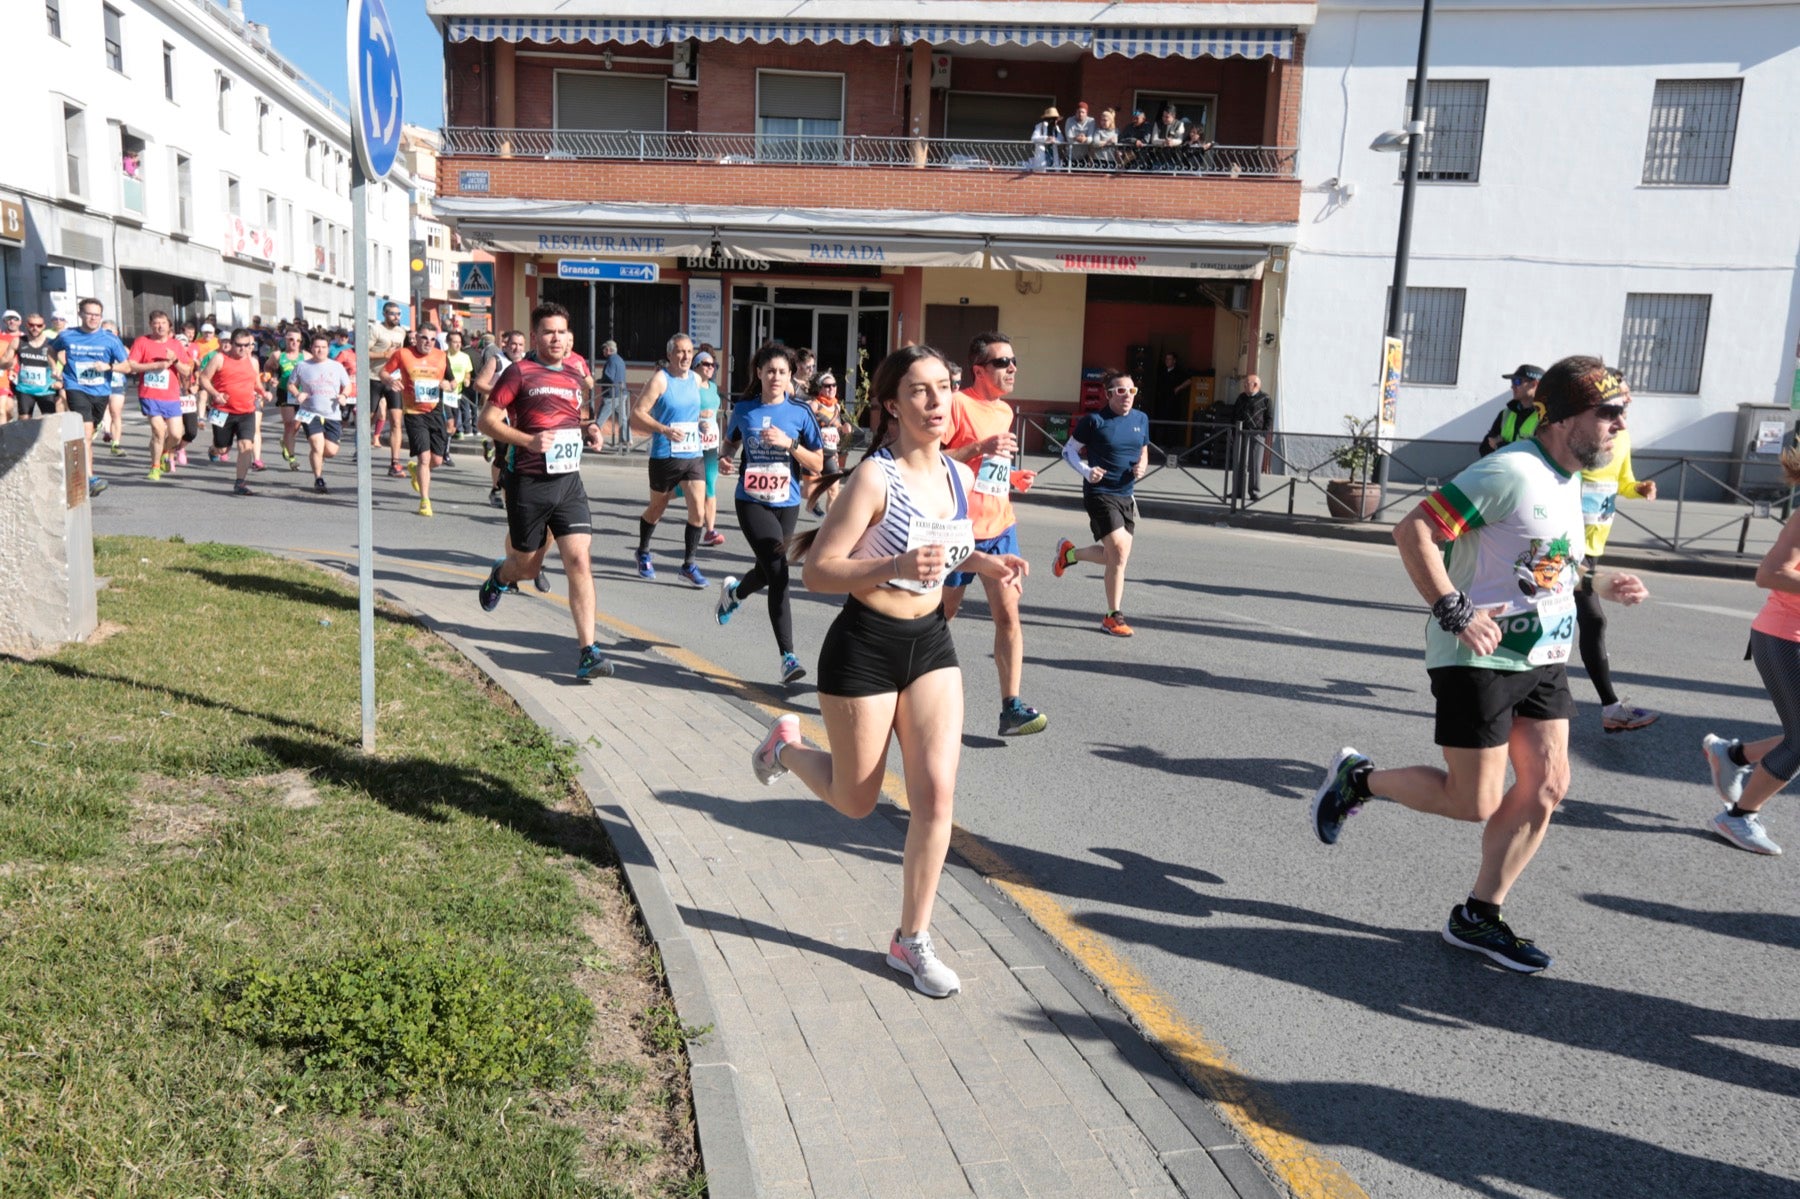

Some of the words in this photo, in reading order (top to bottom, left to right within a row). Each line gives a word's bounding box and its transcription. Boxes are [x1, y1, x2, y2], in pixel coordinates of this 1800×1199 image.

[538, 234, 665, 253] RESTAURANTE
[810, 243, 886, 261] PARADA
[561, 264, 600, 275] Granada
[686, 256, 771, 271] BICHITOS
[554, 442, 579, 460] 287
[987, 462, 1009, 482] 782
[747, 474, 789, 490] 2037
